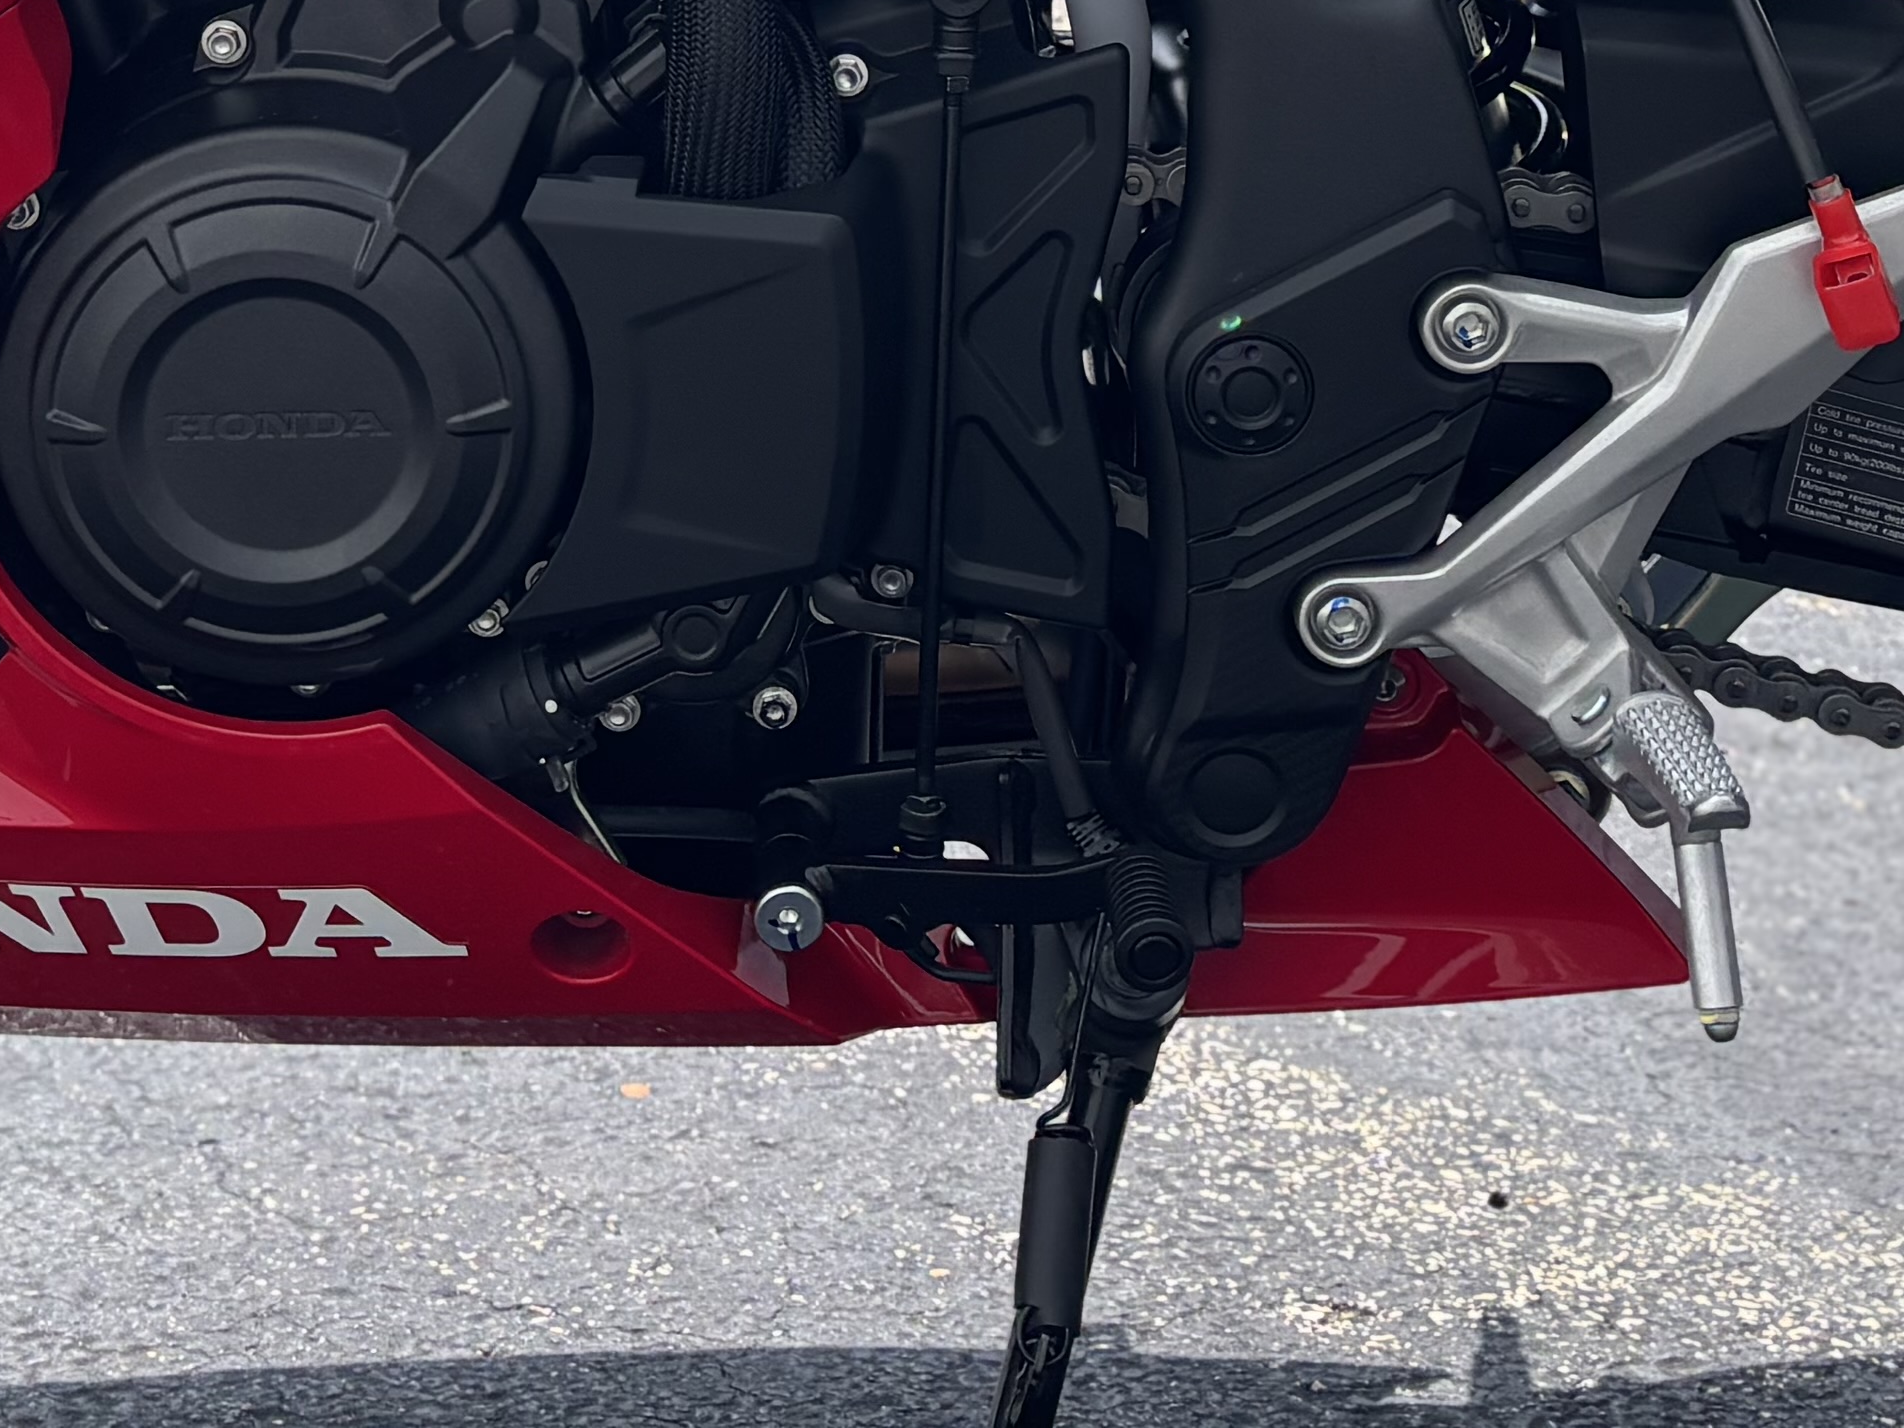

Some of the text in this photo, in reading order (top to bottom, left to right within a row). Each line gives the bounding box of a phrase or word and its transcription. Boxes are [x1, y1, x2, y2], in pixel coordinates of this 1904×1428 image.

[165, 410, 391, 441] HONDA
[1812, 421, 1829, 435] Up
[1808, 442, 1824, 454] Up
